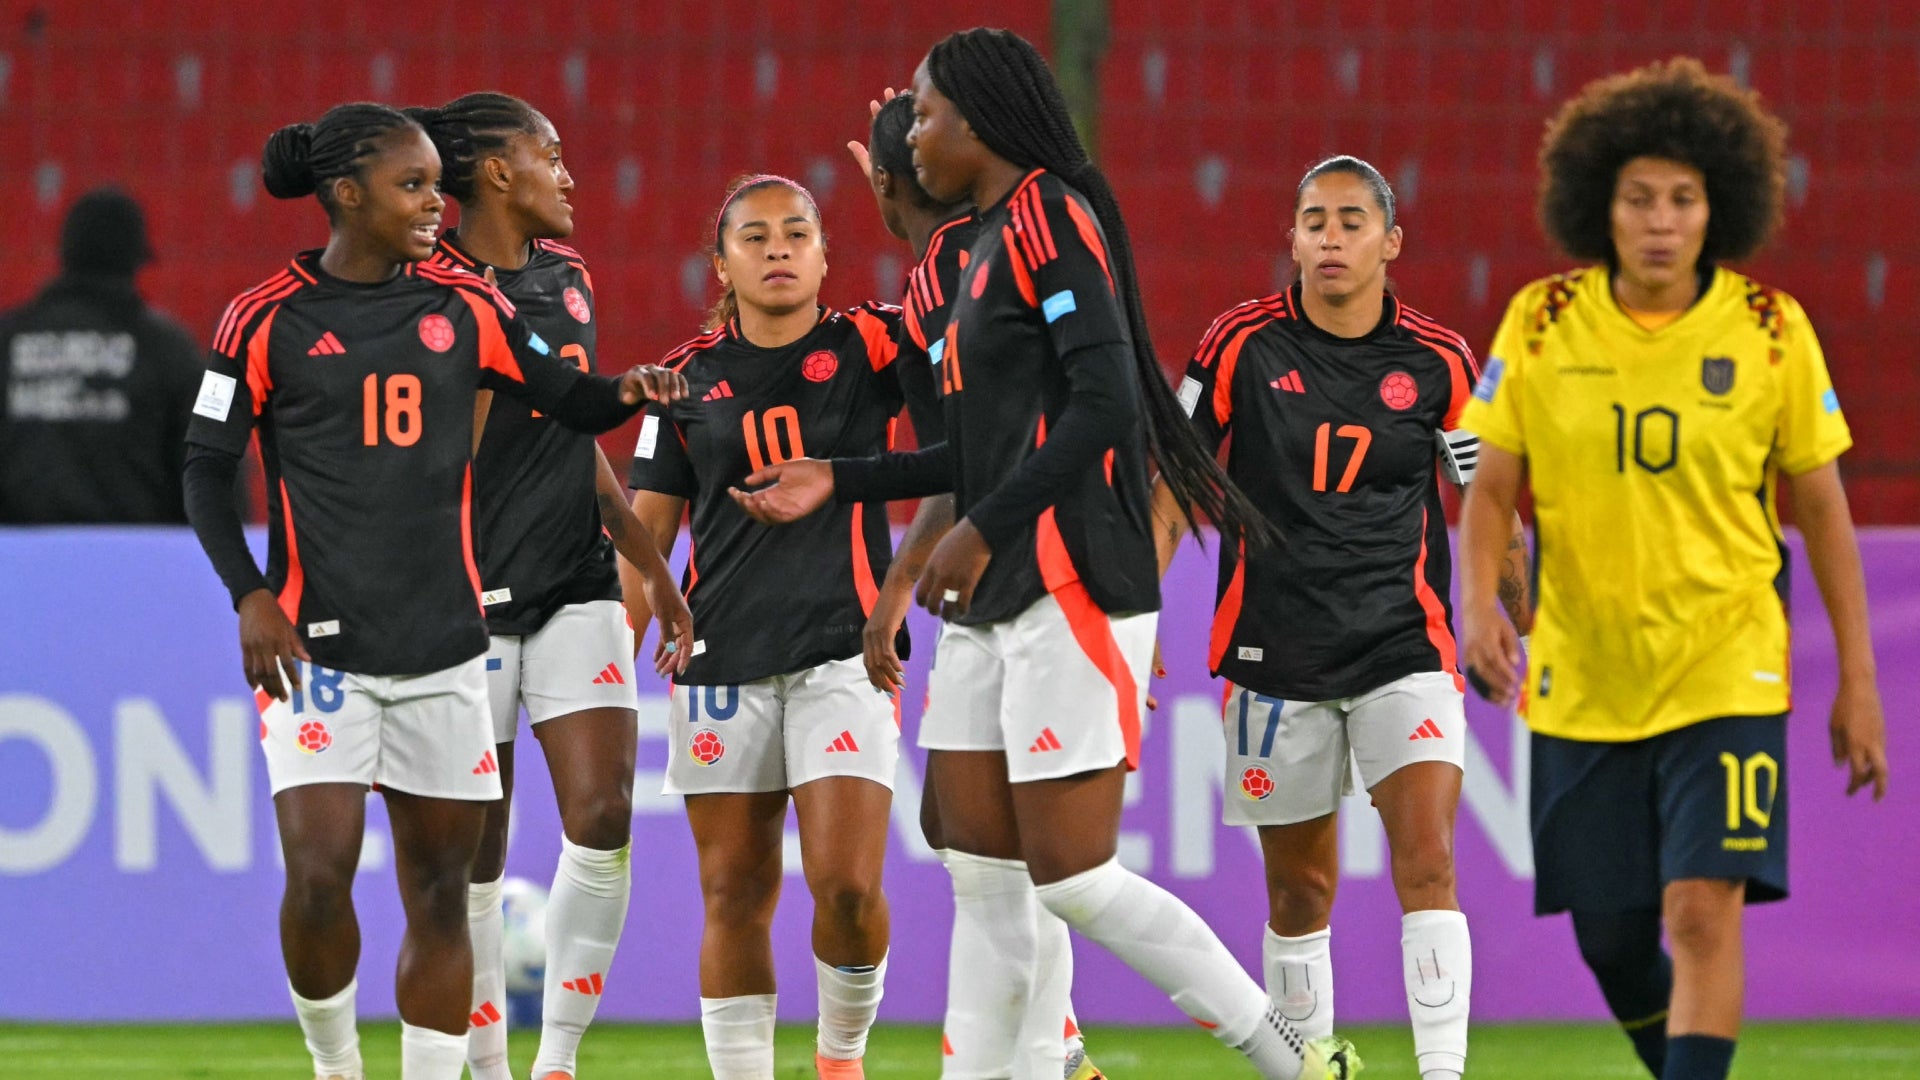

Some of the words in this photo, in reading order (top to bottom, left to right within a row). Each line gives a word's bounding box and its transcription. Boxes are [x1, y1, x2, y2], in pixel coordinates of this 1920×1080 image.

[363, 372, 422, 447] 18
[742, 405, 805, 473] 10
[1612, 402, 1678, 474] 10
[1313, 422, 1372, 493] 17
[292, 659, 345, 714] 18
[1238, 688, 1284, 758] 17
[1720, 751, 1778, 830] 10
